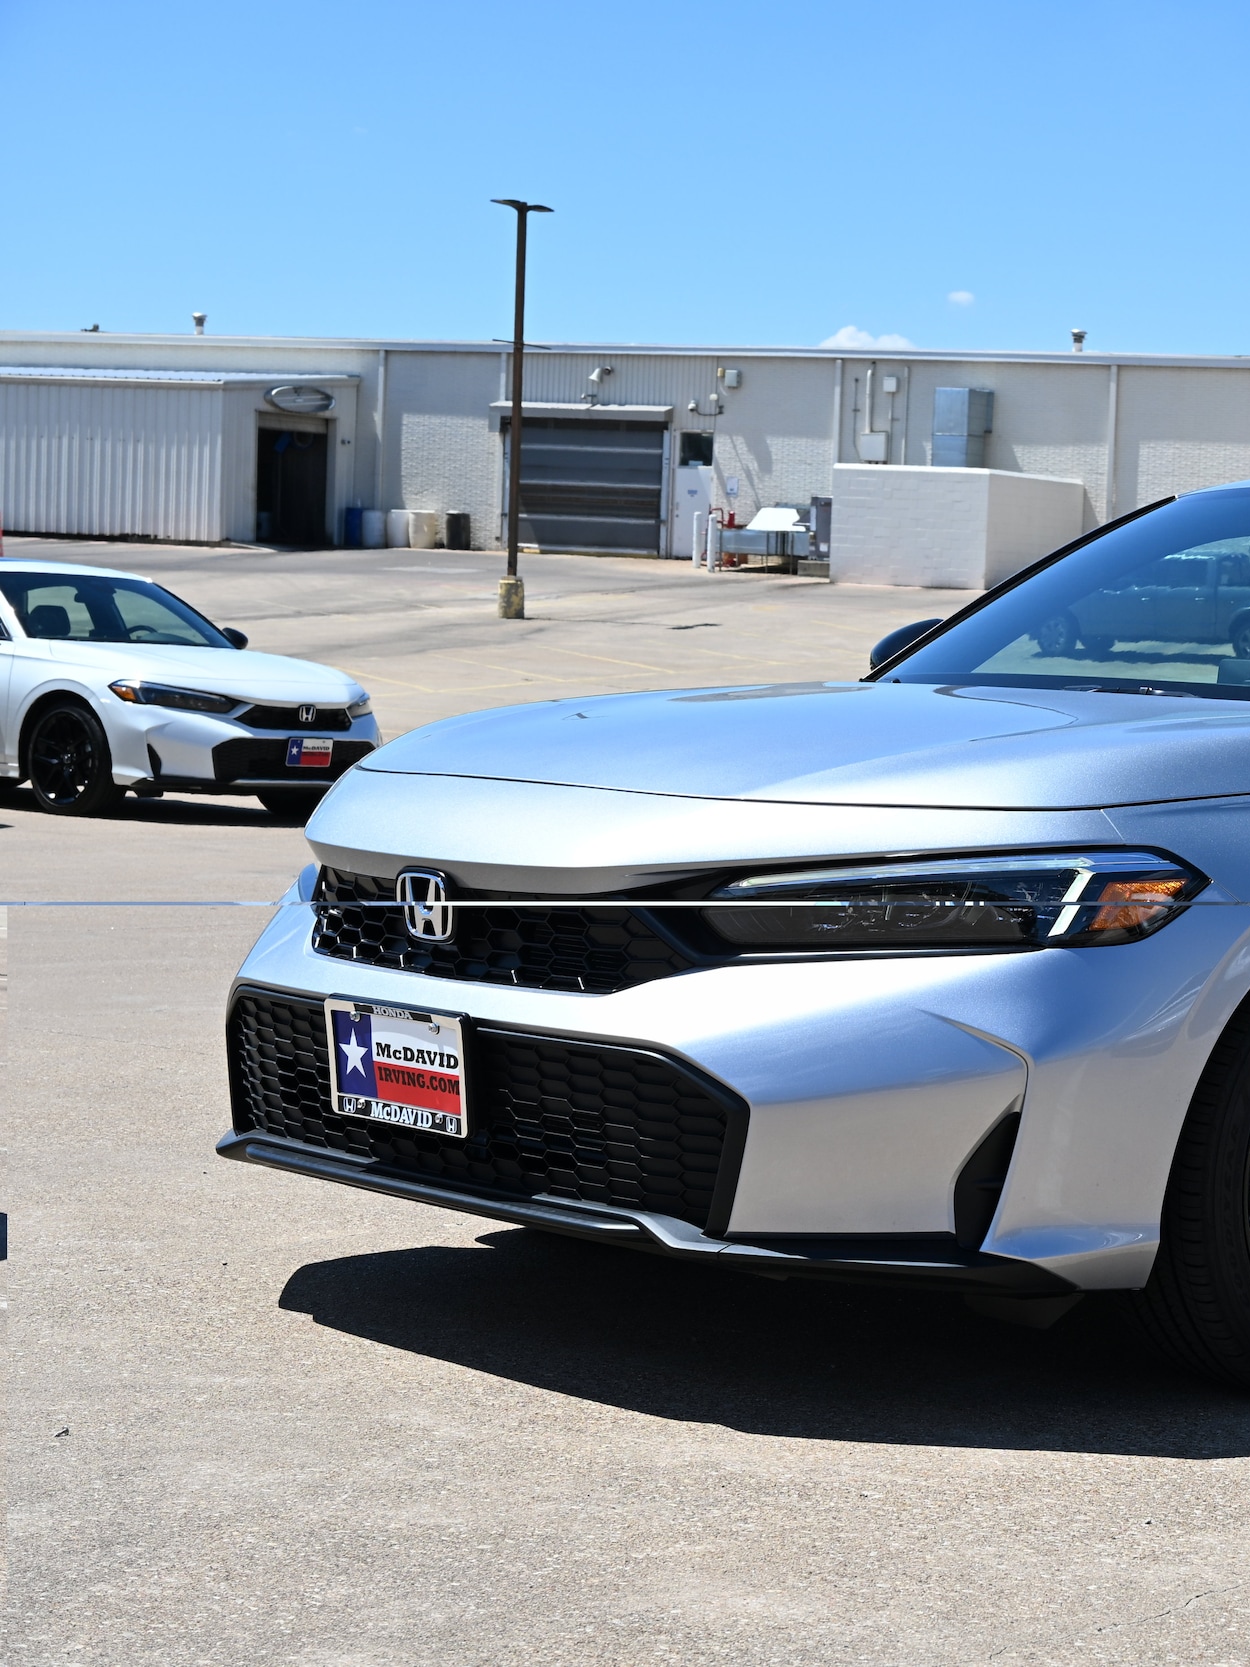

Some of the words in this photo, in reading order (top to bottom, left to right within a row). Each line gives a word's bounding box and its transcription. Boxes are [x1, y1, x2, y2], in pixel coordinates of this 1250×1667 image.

[372, 1006, 413, 1020] HONDA
[375, 1042, 459, 1070] McDAVID
[377, 1066, 460, 1096] IRVING.COM
[370, 1101, 433, 1128] McDAVID
